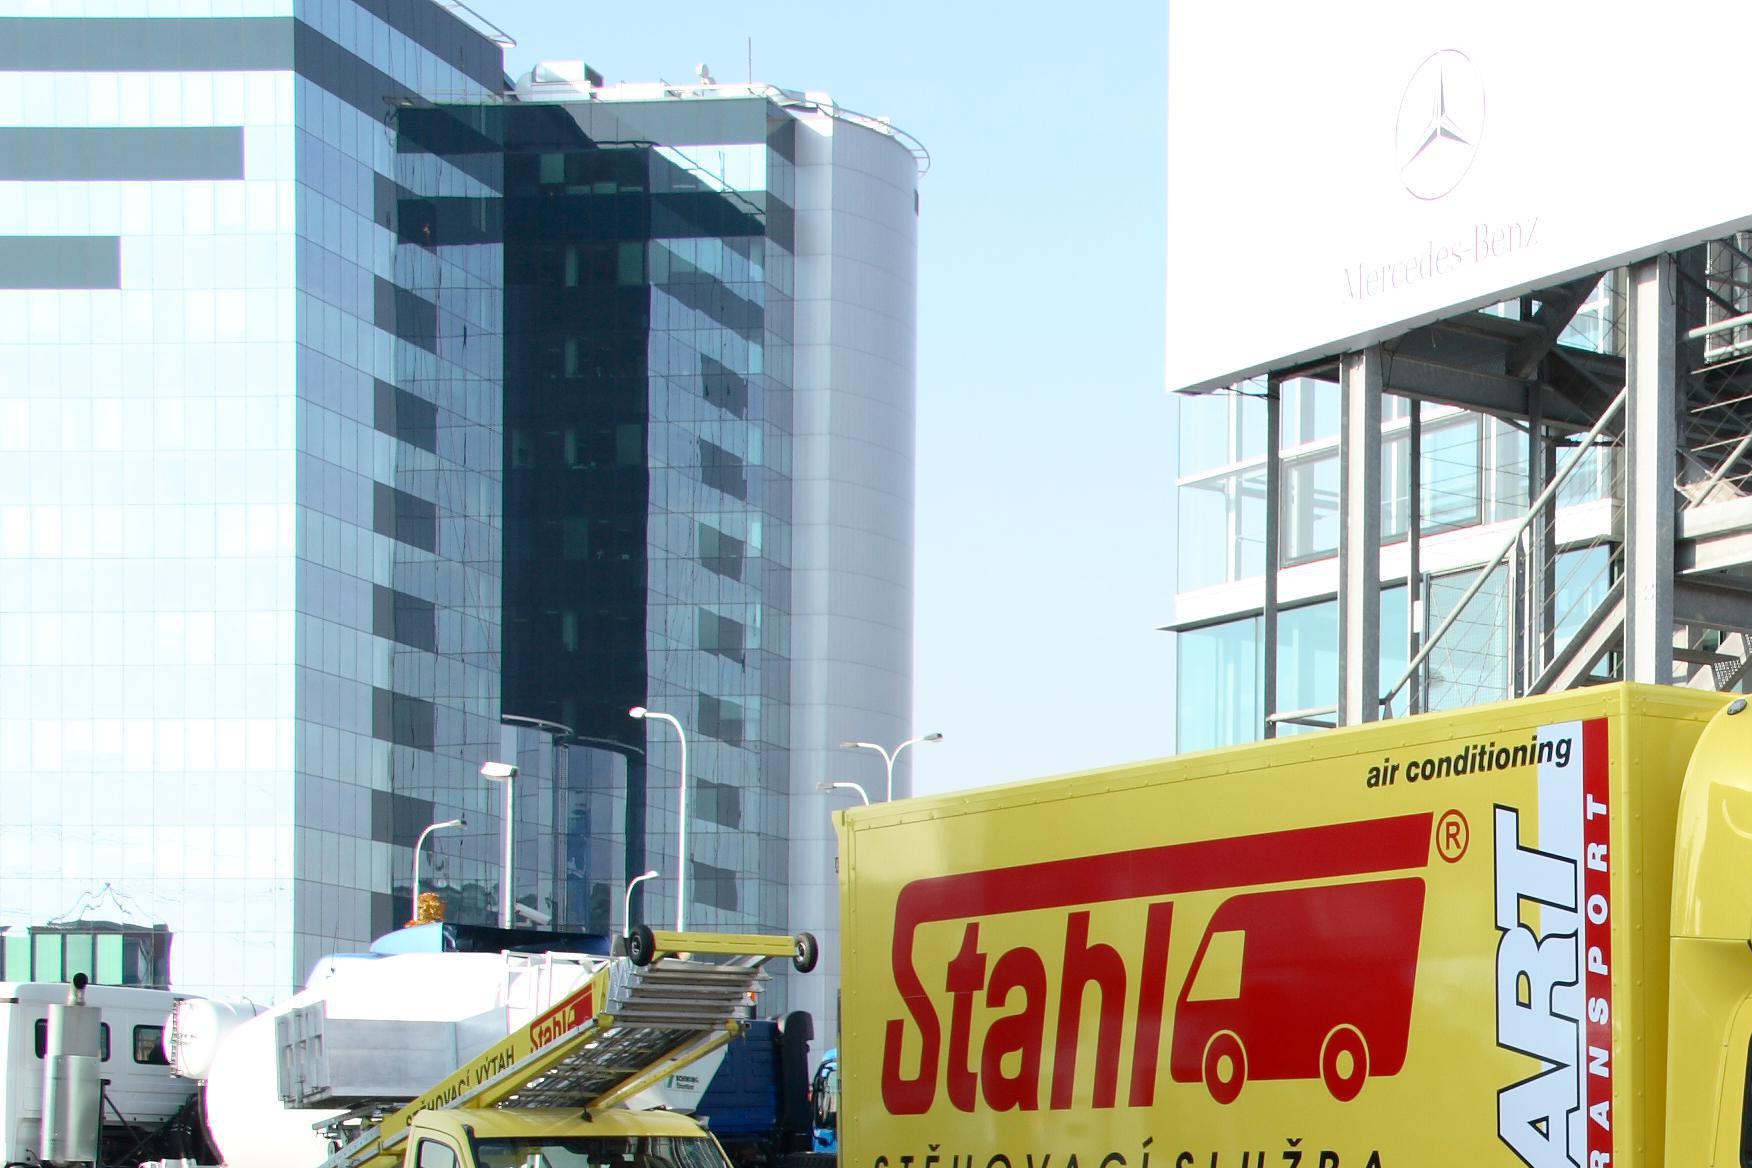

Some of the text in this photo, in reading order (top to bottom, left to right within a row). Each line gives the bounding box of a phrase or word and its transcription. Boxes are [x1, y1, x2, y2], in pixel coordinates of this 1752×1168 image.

[1342, 216, 1542, 303] Mercedes-Benz
[1366, 735, 1572, 788] air conditioning
[881, 872, 1175, 1116] Stahl
